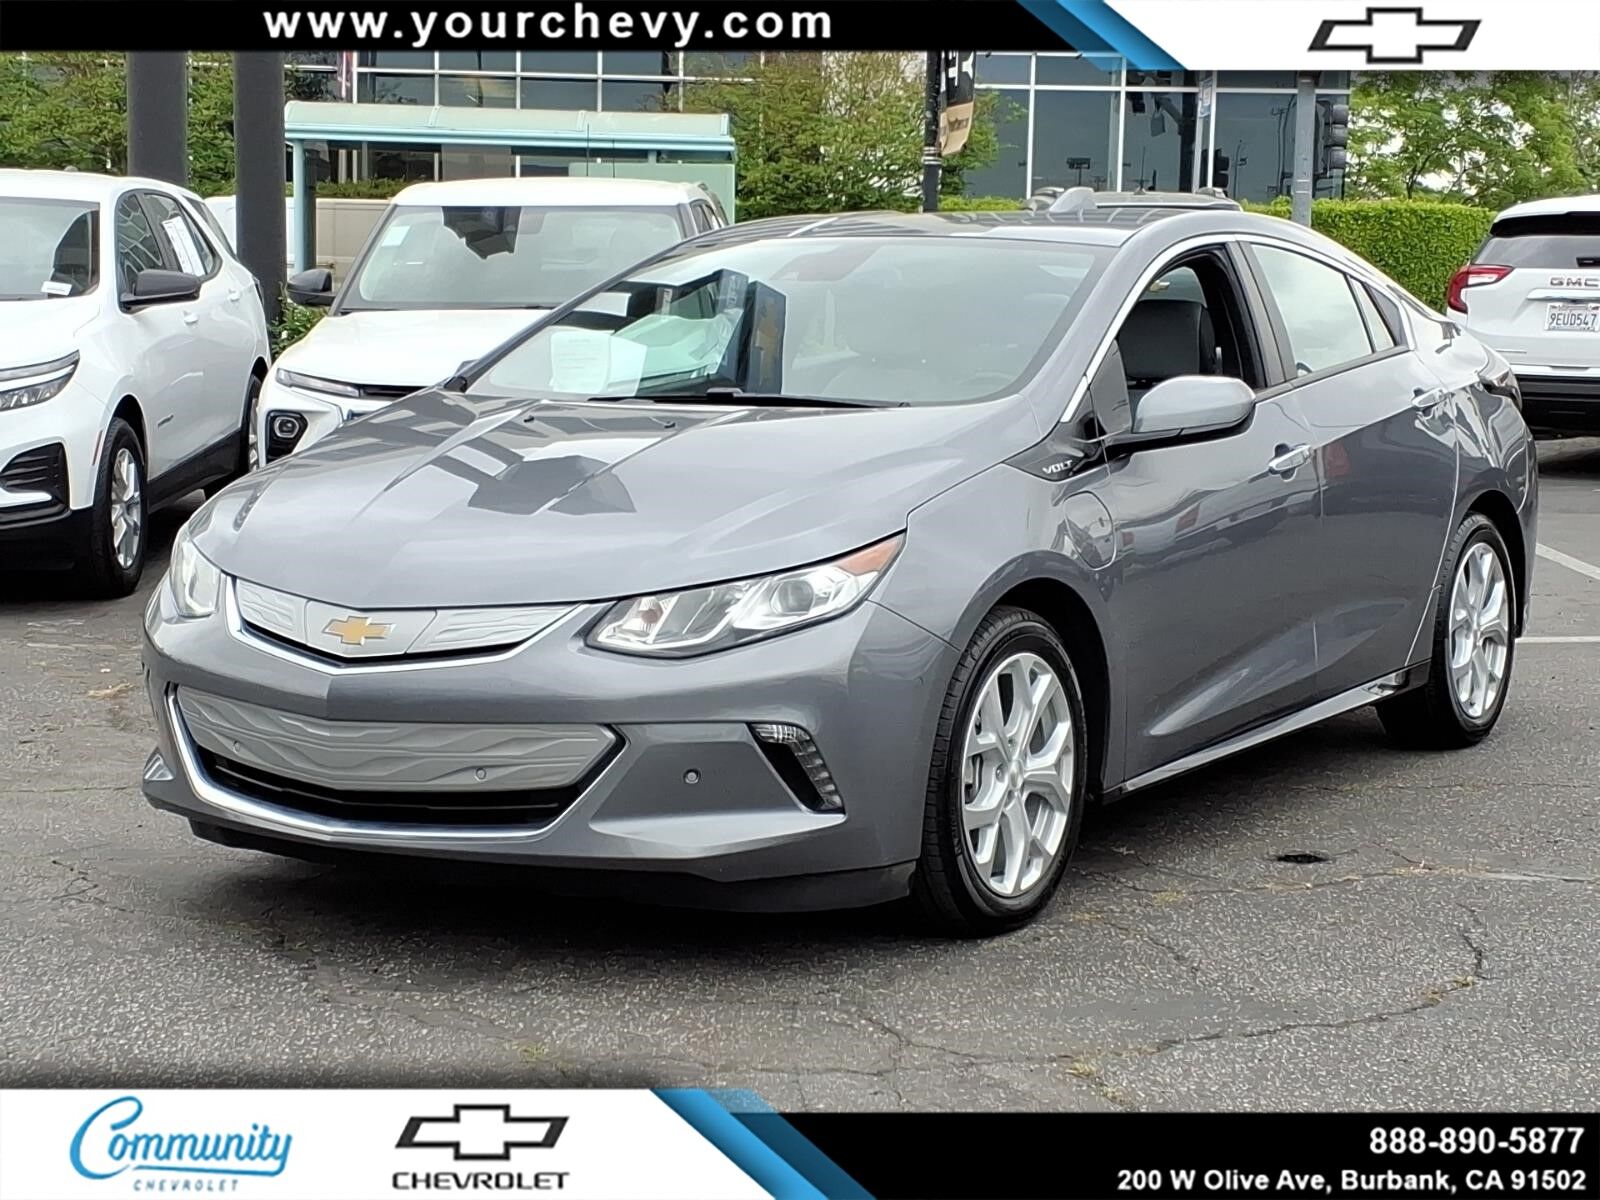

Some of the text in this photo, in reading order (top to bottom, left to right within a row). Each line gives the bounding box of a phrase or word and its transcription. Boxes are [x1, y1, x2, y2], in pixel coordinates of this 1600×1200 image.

[1550, 277, 1600, 287] GMC
[1550, 312, 1597, 326] 9EUD547
[1042, 459, 1073, 474] VOLT
